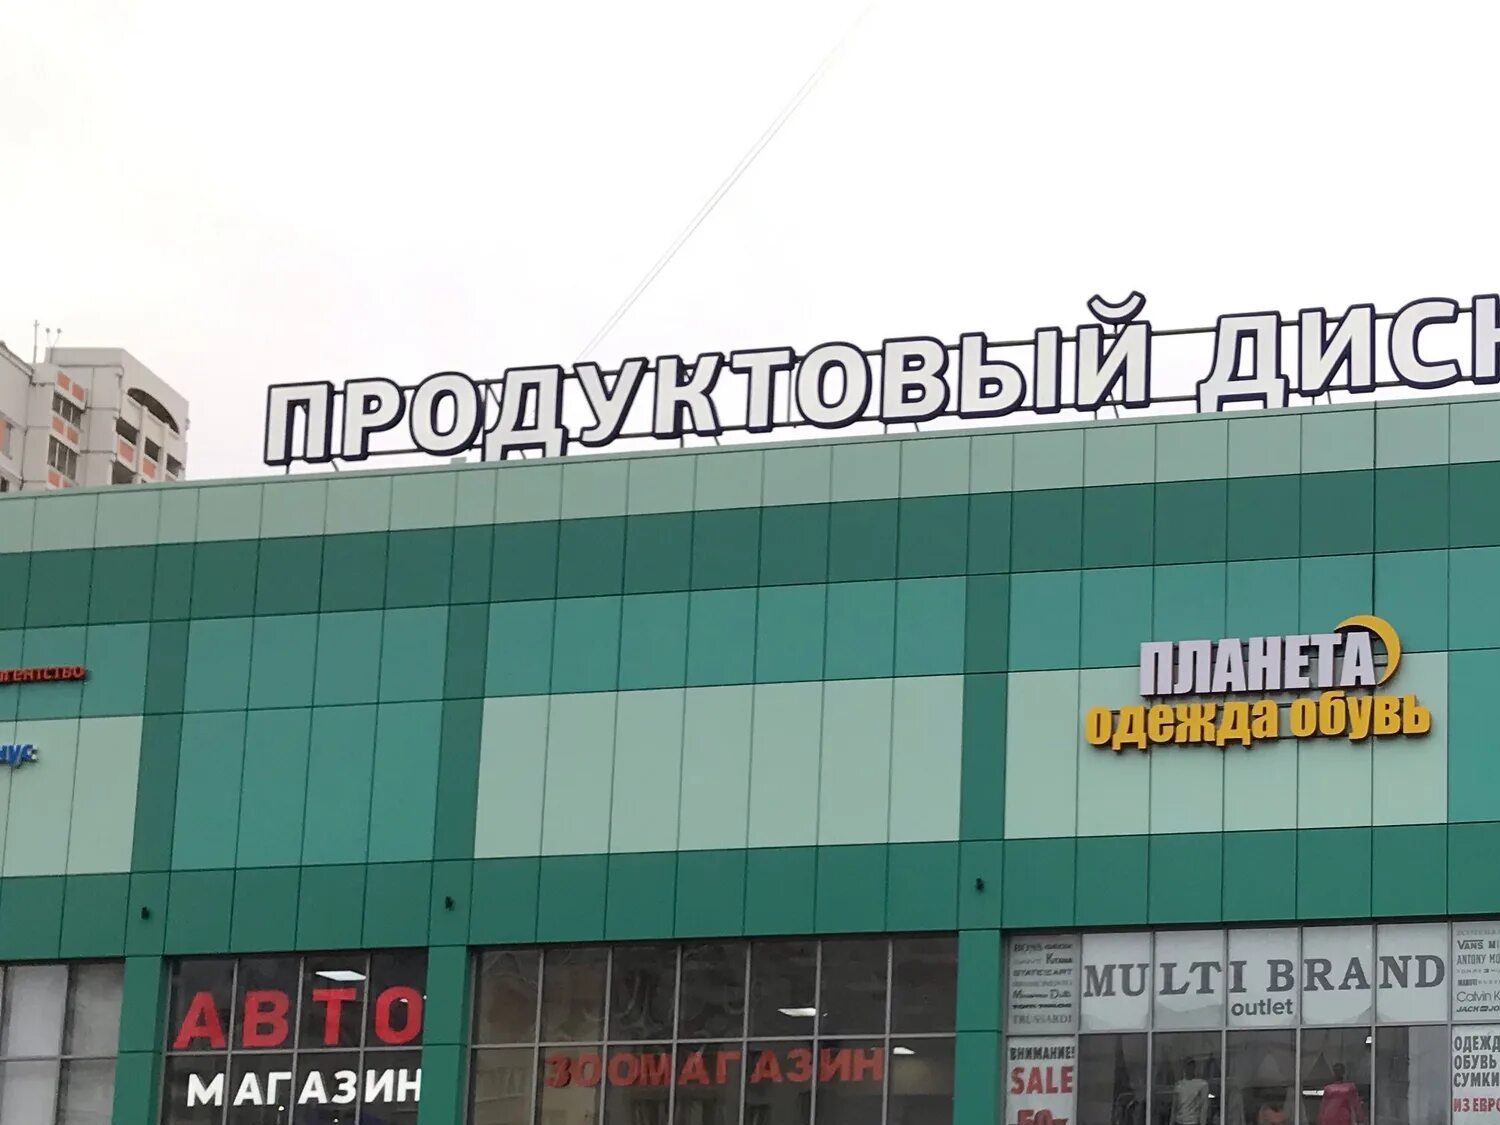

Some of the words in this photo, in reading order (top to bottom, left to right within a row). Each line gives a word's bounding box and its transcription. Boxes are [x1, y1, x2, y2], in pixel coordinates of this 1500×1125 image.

[264, 290, 1153, 465] ПРОДУКТОВЫЙ
[1139, 631, 1377, 697] ПЛАНЕТА
[1085, 698, 1279, 751] одежда
[1289, 690, 1432, 741] обувь
[1457, 939, 1484, 950] VANS
[1083, 960, 1248, 998] MULTI
[1266, 954, 1445, 994] BRAND
[173, 986, 423, 1050] АВТО
[1231, 1000, 1294, 1017] outlet
[543, 1046, 885, 1088] ЗООМАГАЗИН
[1009, 1046, 1076, 1061] ВНИМАНИЕ!
[1453, 1055, 1498, 1070] ОБУВЬ
[187, 1068, 422, 1107] МАГАЗИН
[1010, 1066, 1075, 1095] SALE
[1453, 1071, 1500, 1087] СУМКИ
[1453, 1098, 1470, 1112] ИЗ
